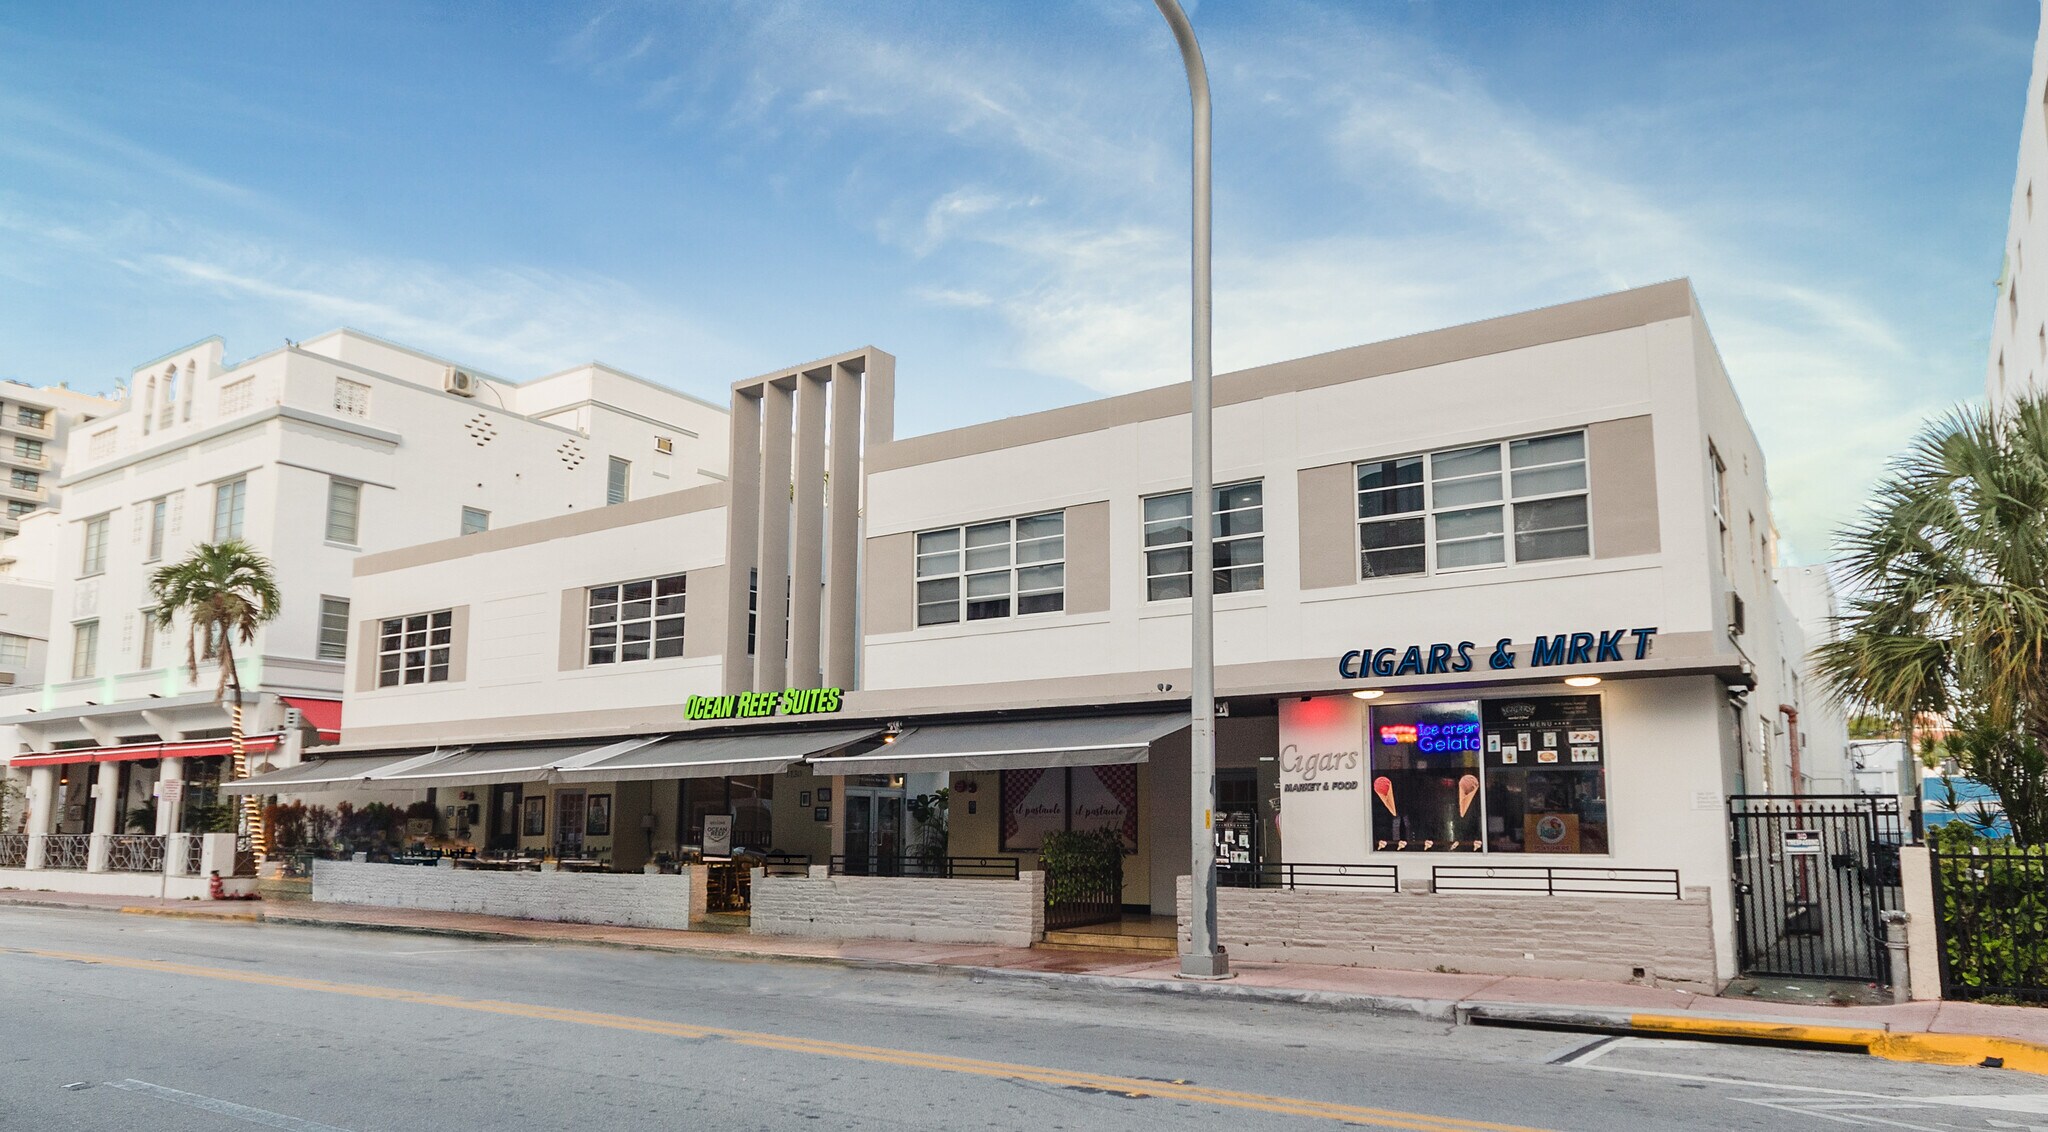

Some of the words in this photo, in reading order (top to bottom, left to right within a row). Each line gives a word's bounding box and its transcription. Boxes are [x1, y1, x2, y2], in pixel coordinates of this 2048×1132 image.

[1339, 641, 1476, 679] CIGARS
[1489, 637, 1517, 670] &
[1531, 627, 1658, 667] MRKT
[684, 694, 735, 720] OCEAN
[737, 690, 781, 718] REEF
[780, 687, 844, 715] SUITES
[1418, 723, 1440, 736] Ice
[1281, 744, 1359, 781] Cigars
[1284, 783, 1321, 792] MARKET
[1323, 782, 1329, 791] &
[1332, 781, 1358, 790] FOOD
